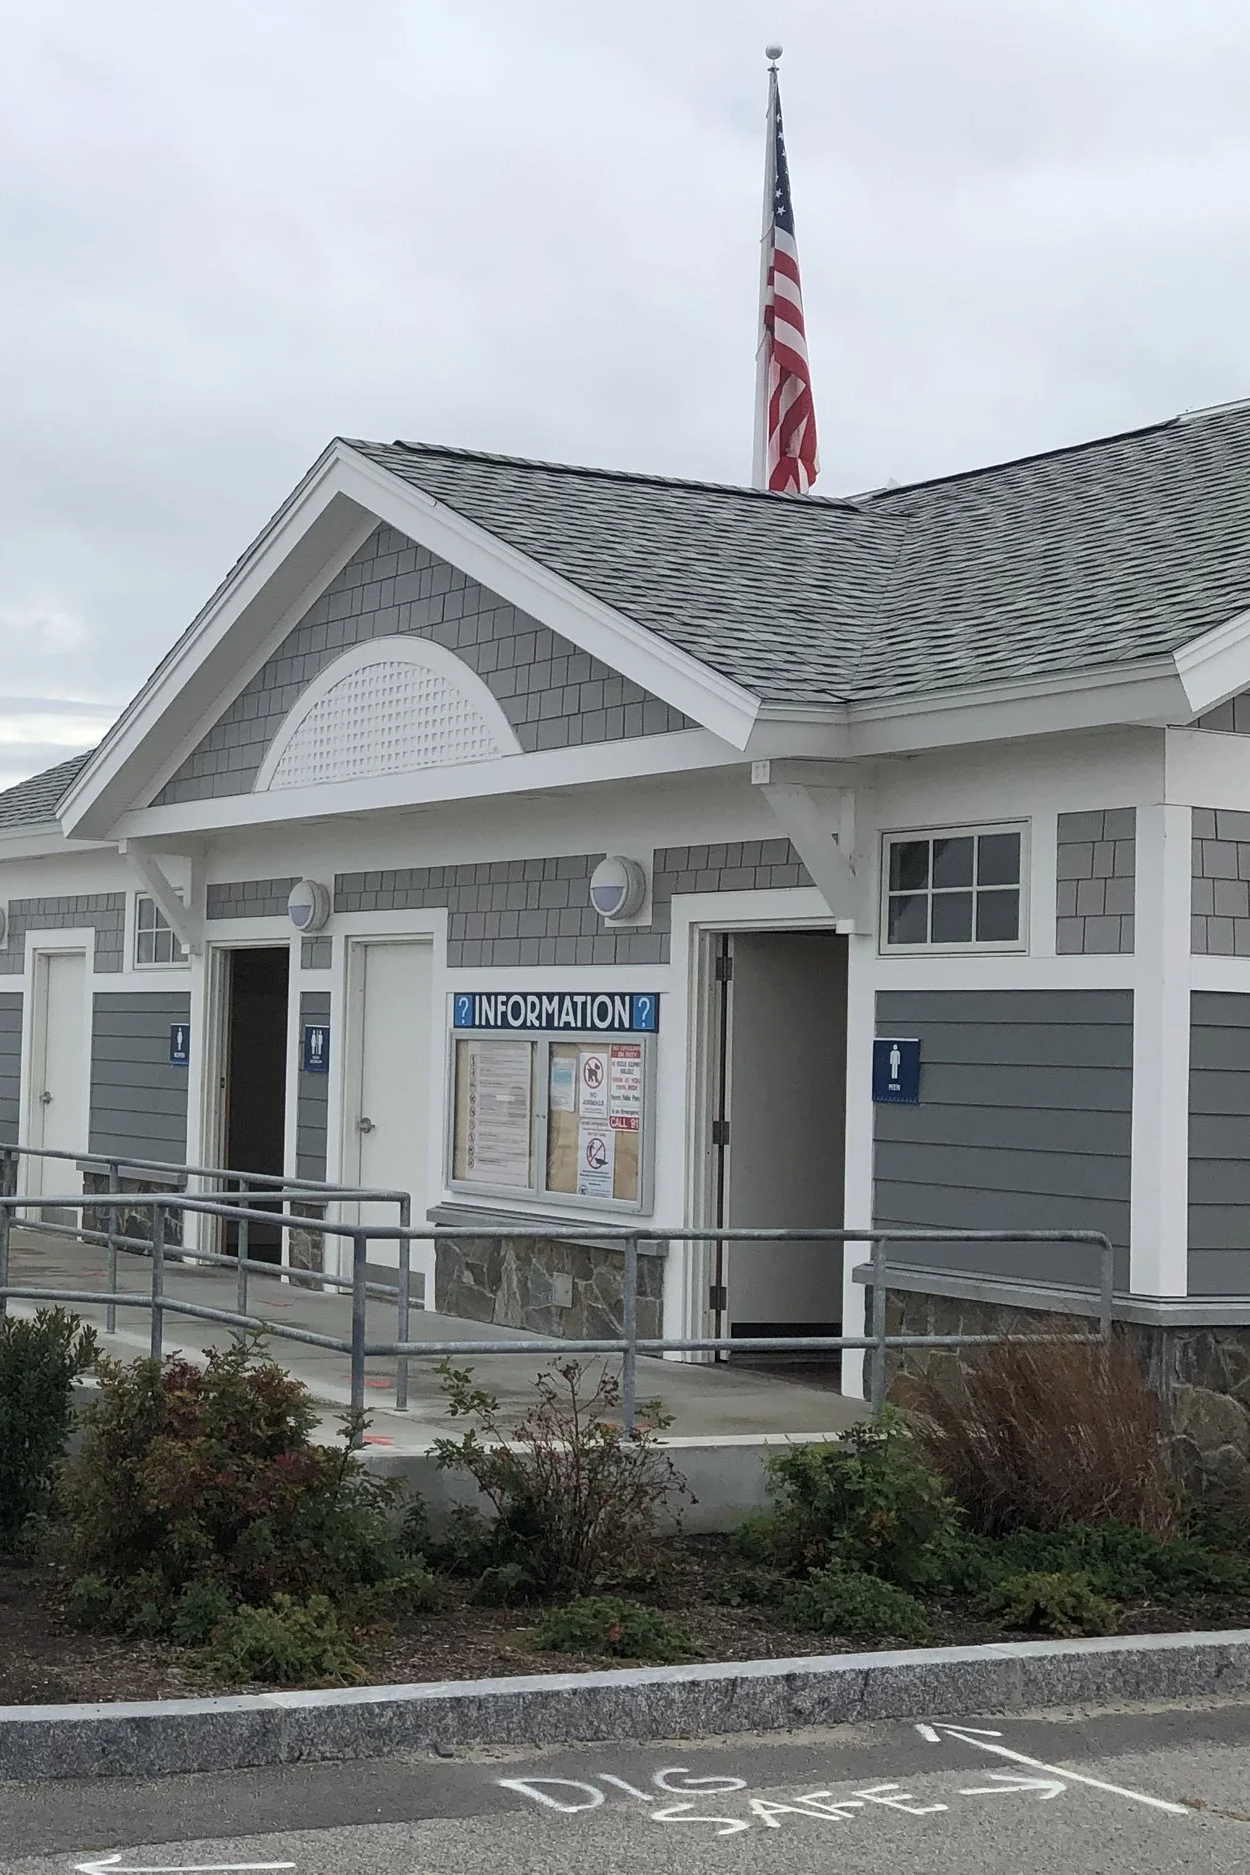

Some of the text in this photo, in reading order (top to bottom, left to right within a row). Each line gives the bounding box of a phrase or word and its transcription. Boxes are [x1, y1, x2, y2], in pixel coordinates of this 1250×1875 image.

[474, 994, 630, 1028] INFORMATION
[888, 1083, 901, 1091] MEN
[610, 1117, 628, 1128] CALL
[630, 1119, 639, 1129] 91
[497, 1766, 748, 1814] DIG
[650, 1783, 949, 1836] SAFE
